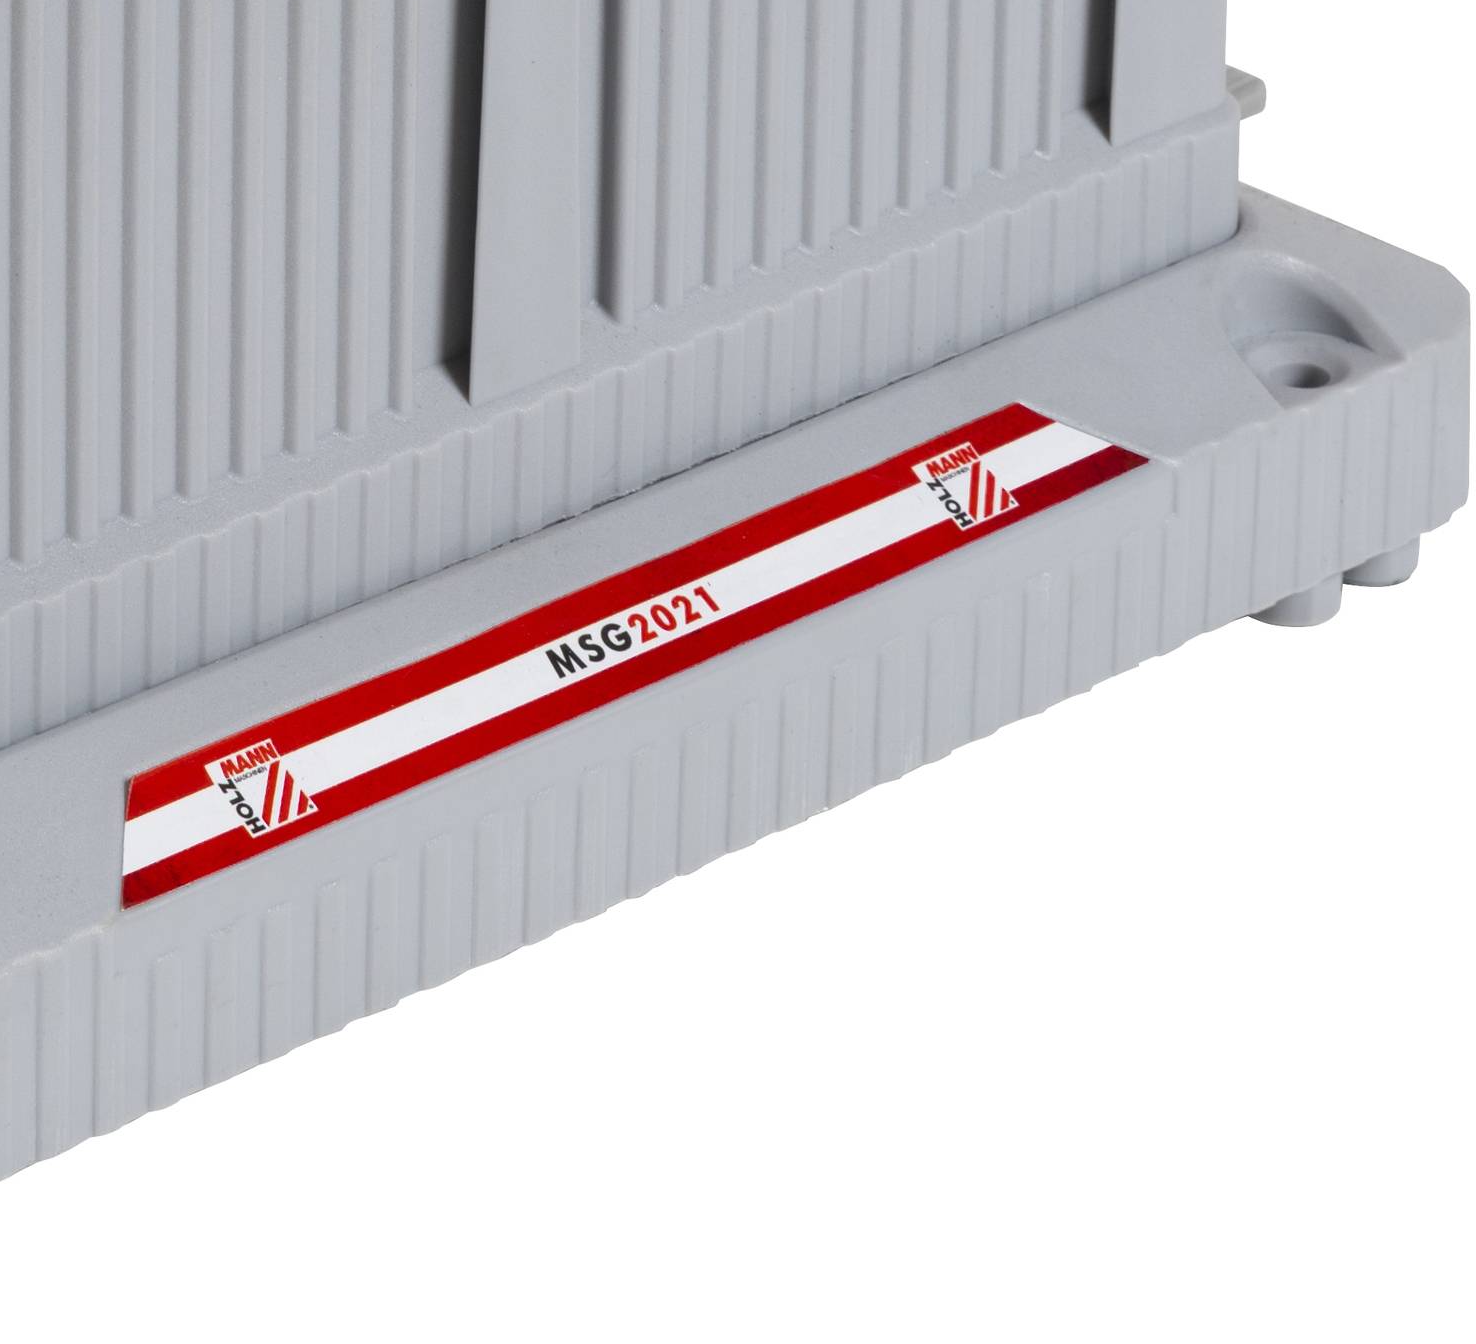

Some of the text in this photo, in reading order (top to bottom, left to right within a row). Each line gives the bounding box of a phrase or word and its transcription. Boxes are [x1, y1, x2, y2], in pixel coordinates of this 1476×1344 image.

[926, 444, 979, 478] MANN
[926, 477, 974, 528] HOLZ
[545, 585, 721, 679] MSG2021
[219, 742, 278, 779] MANN
[218, 777, 267, 834] HOLZ
